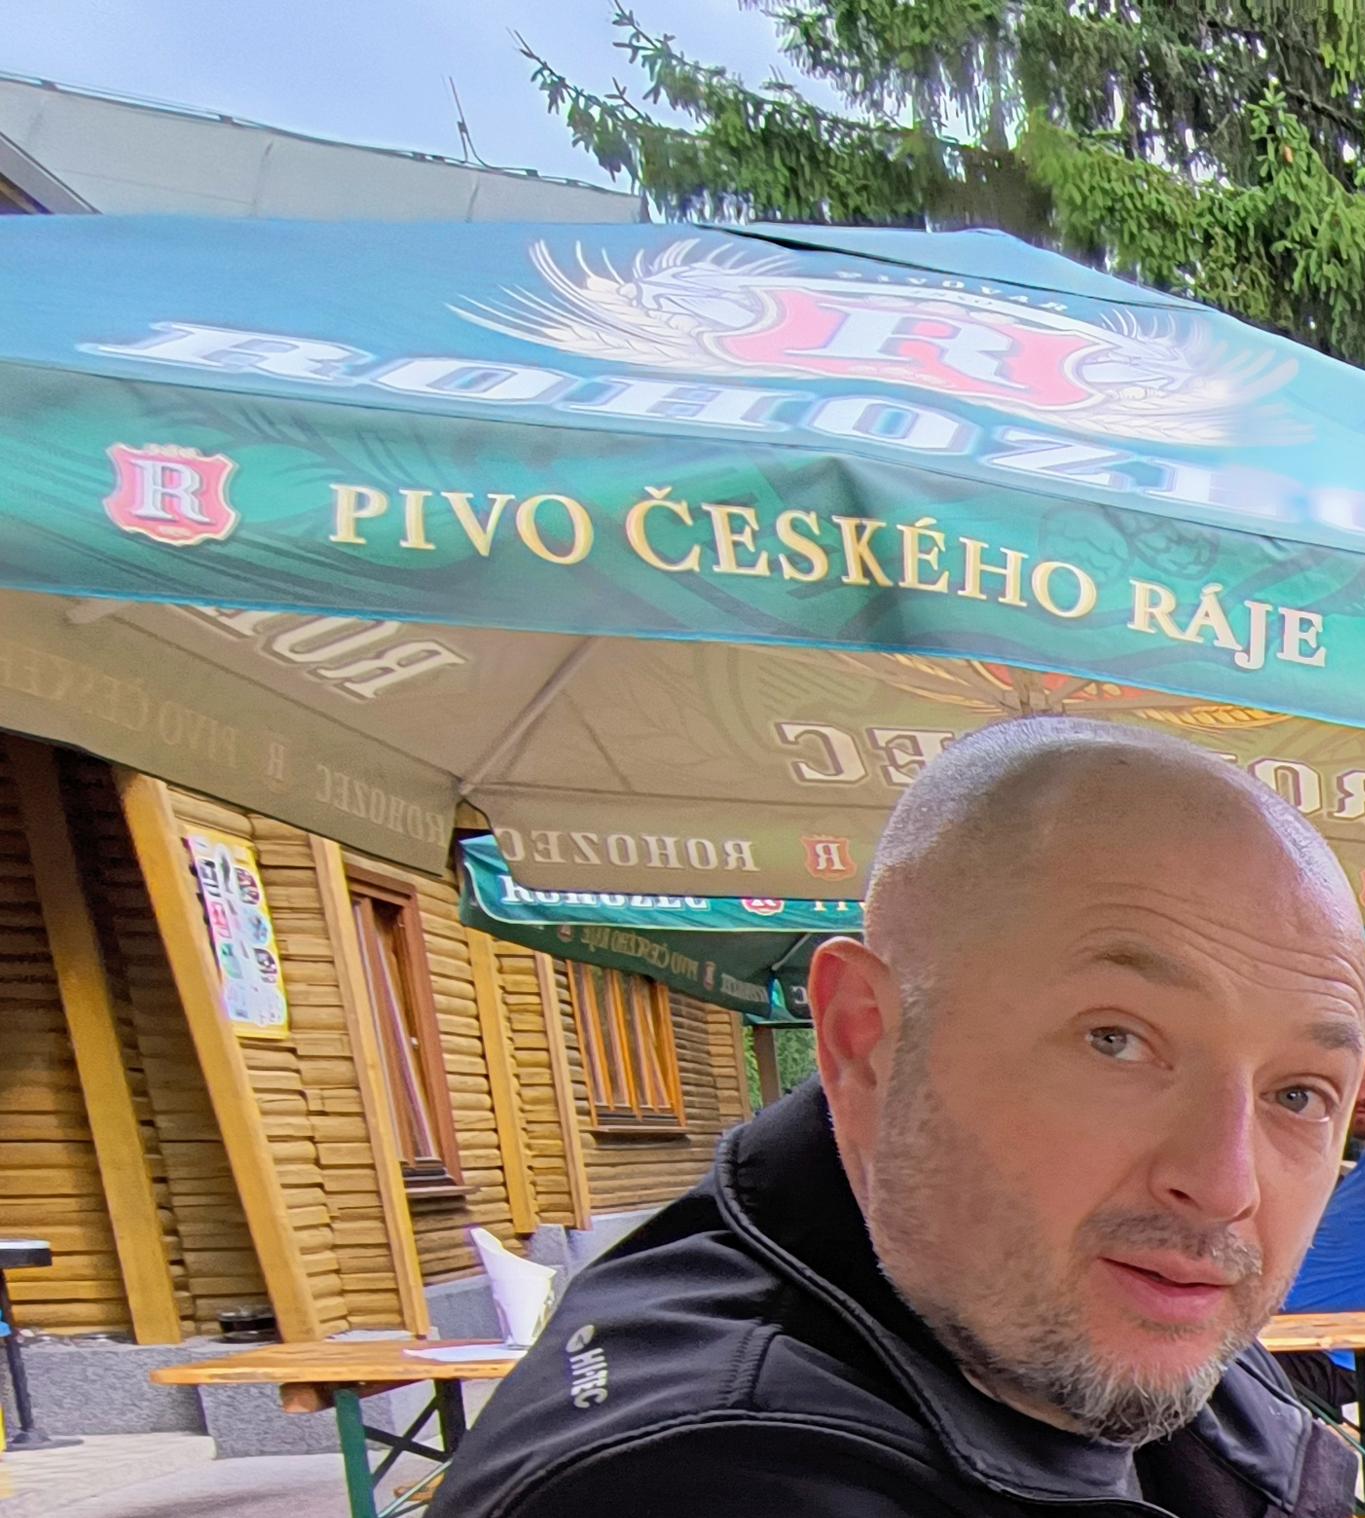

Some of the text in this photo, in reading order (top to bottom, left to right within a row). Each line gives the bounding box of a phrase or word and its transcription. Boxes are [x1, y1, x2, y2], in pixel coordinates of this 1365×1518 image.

[128, 459, 212, 525] R
[329, 483, 595, 566] PIVO
[624, 486, 1097, 620] ČESKÉHO
[1127, 582, 1328, 670] RÁJE
[568, 1347, 609, 1409] HI-TEC
